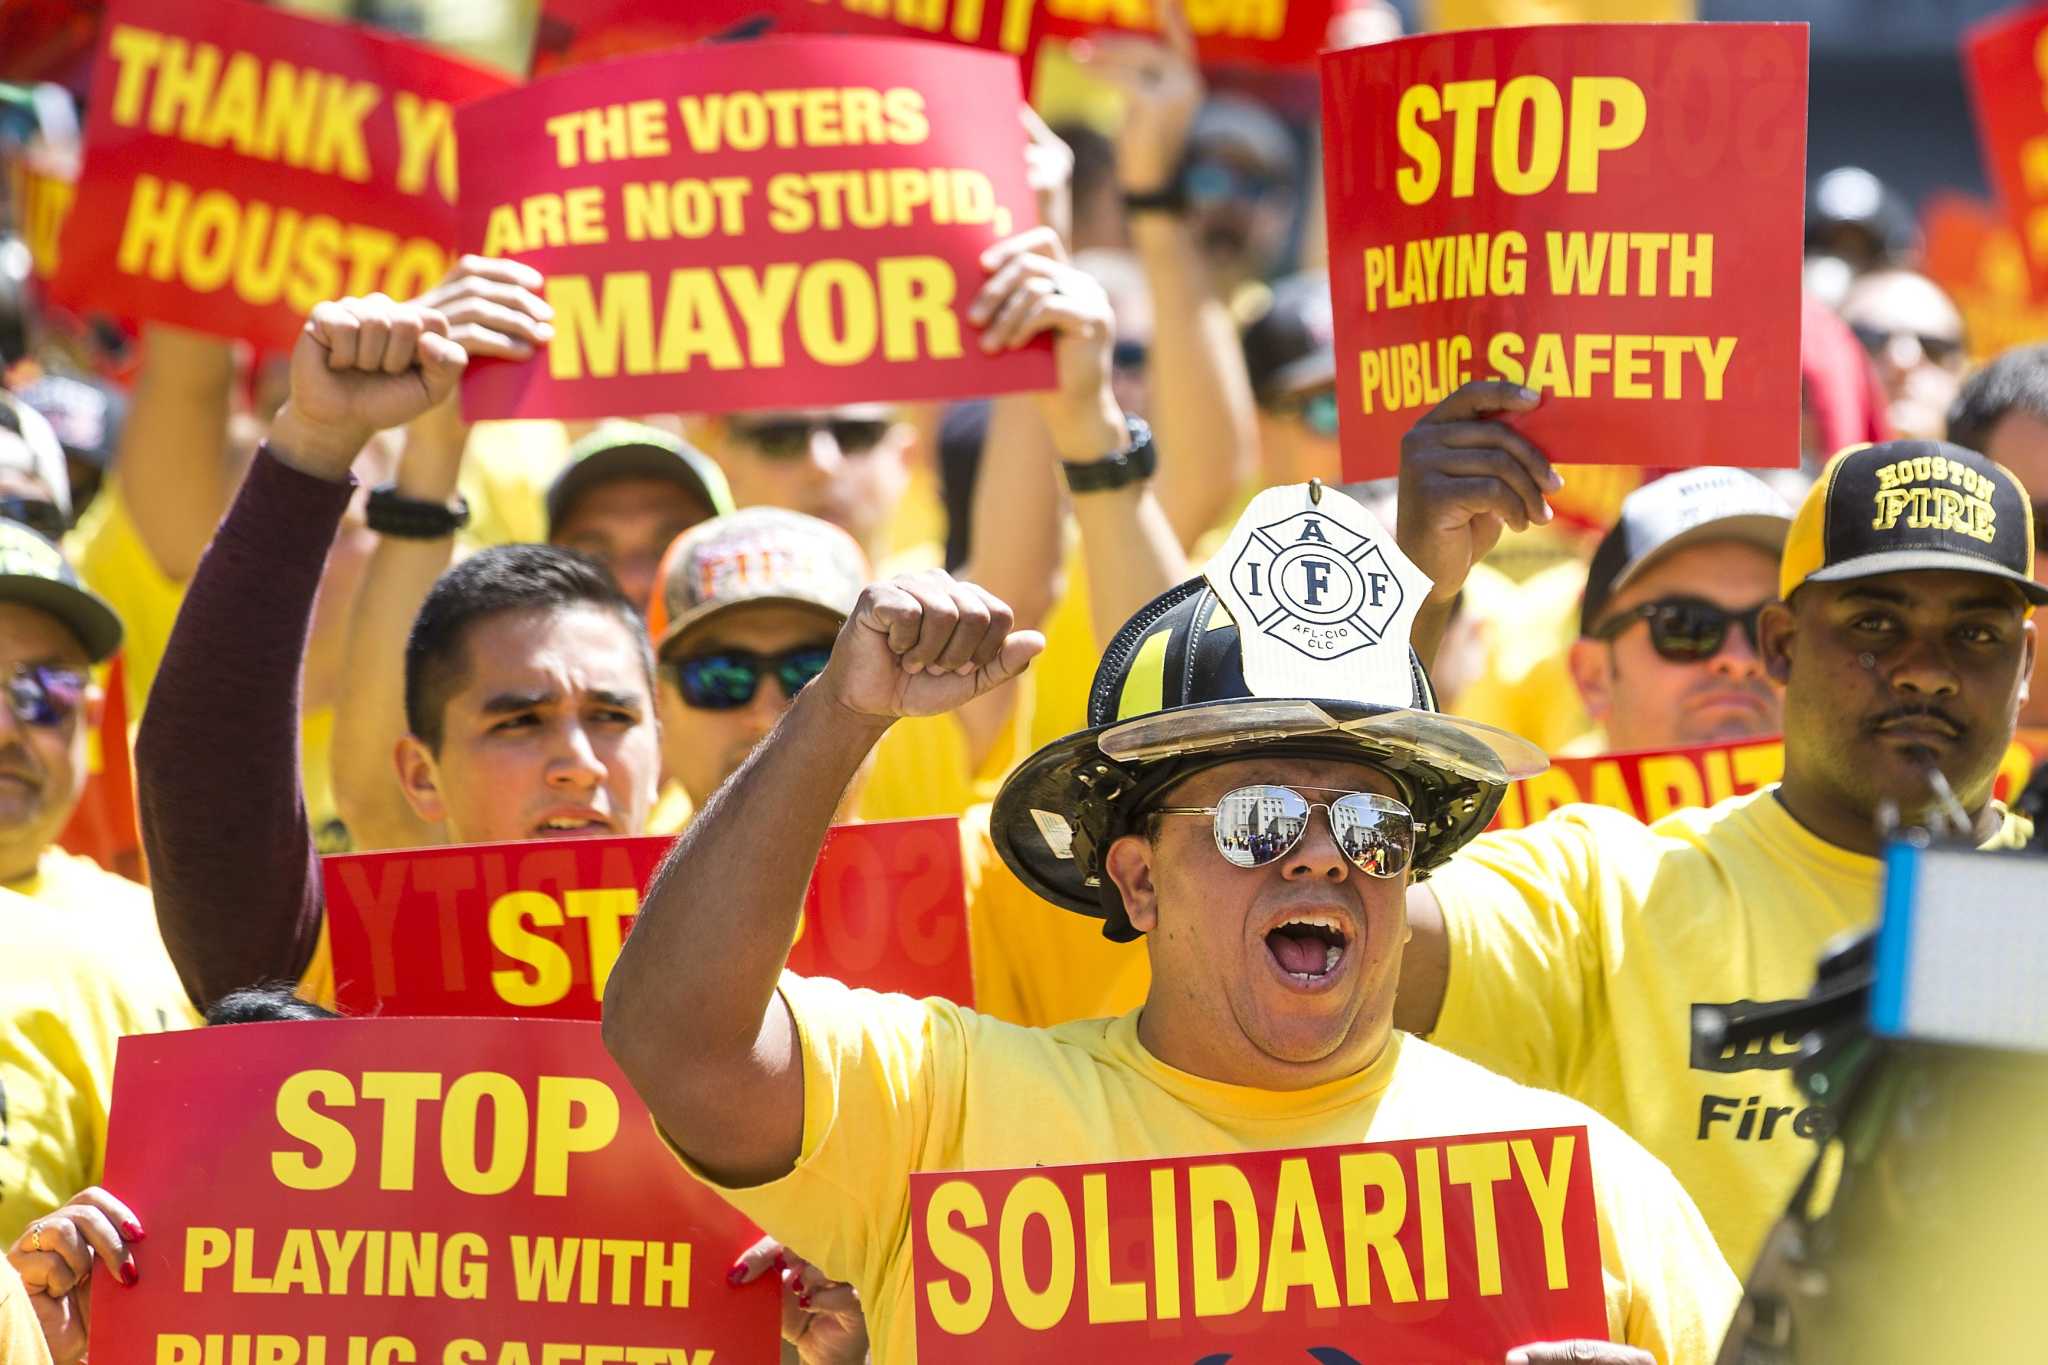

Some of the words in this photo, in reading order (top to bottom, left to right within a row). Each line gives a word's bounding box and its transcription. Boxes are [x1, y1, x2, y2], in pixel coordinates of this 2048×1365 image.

[110, 24, 381, 183] THANK
[545, 100, 670, 168] THE
[678, 86, 930, 154] VOTERS
[1396, 74, 1648, 206] STOP
[117, 175, 452, 314] HOUSTO
[482, 186, 609, 257] ARE
[621, 176, 752, 241] NOT
[767, 167, 1012, 237] STUPID,
[1363, 230, 1528, 313] PLAYING
[1545, 230, 1715, 298] WITH
[545, 256, 965, 381] MAYOR
[1359, 335, 1473, 416] PUBLIC
[1486, 331, 1739, 401] SAFETY
[1872, 487, 1997, 545] FIRE
[1875, 456, 1997, 502] HOUSTON
[1296, 519, 1333, 545] A
[1300, 560, 1331, 606] F
[1367, 572, 1389, 607] F
[1292, 623, 1348, 639] AFL-CIO
[1307, 639, 1335, 650] CLC
[271, 1069, 621, 1197] STOP
[183, 1226, 489, 1300] PLAYING
[511, 1235, 692, 1308] WITH
[925, 1134, 1576, 1335] SOLIDARITY
